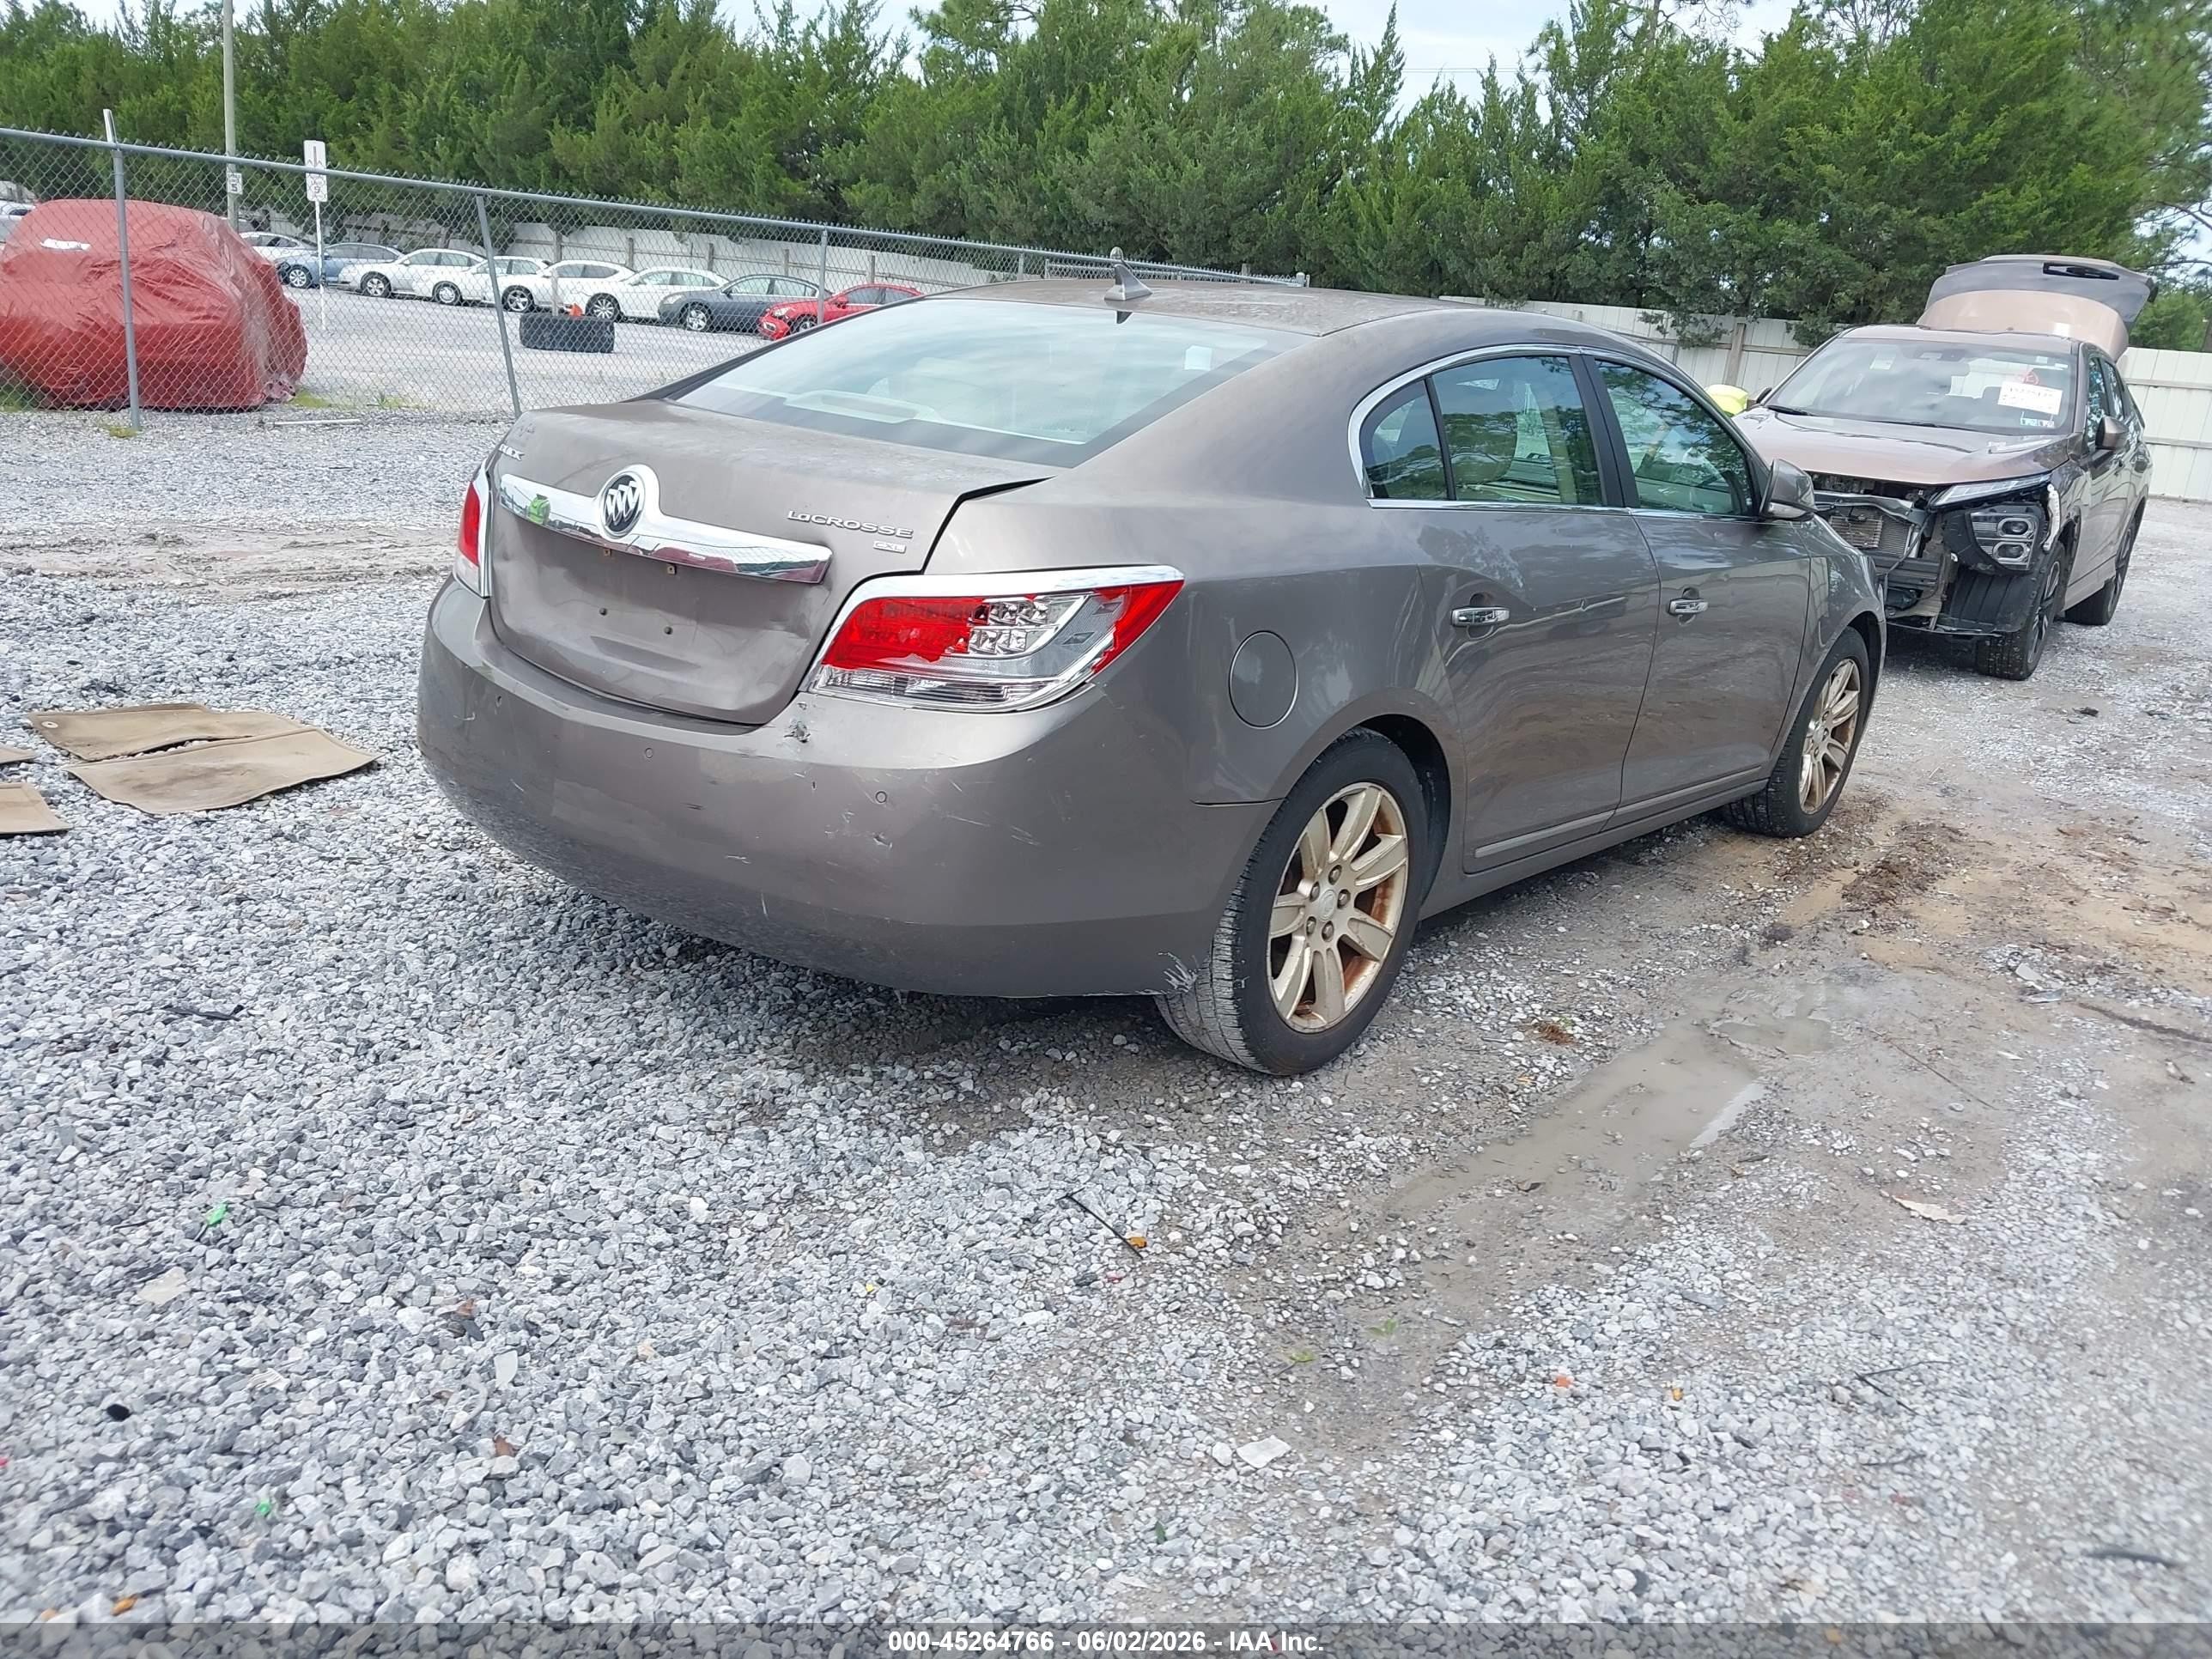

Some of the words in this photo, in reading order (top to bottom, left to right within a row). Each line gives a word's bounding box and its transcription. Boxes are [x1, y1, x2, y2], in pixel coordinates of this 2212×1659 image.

[231, 184, 238, 192] 5
[787, 510, 914, 538] LaCROSSE
[874, 541, 905, 553] CXL
